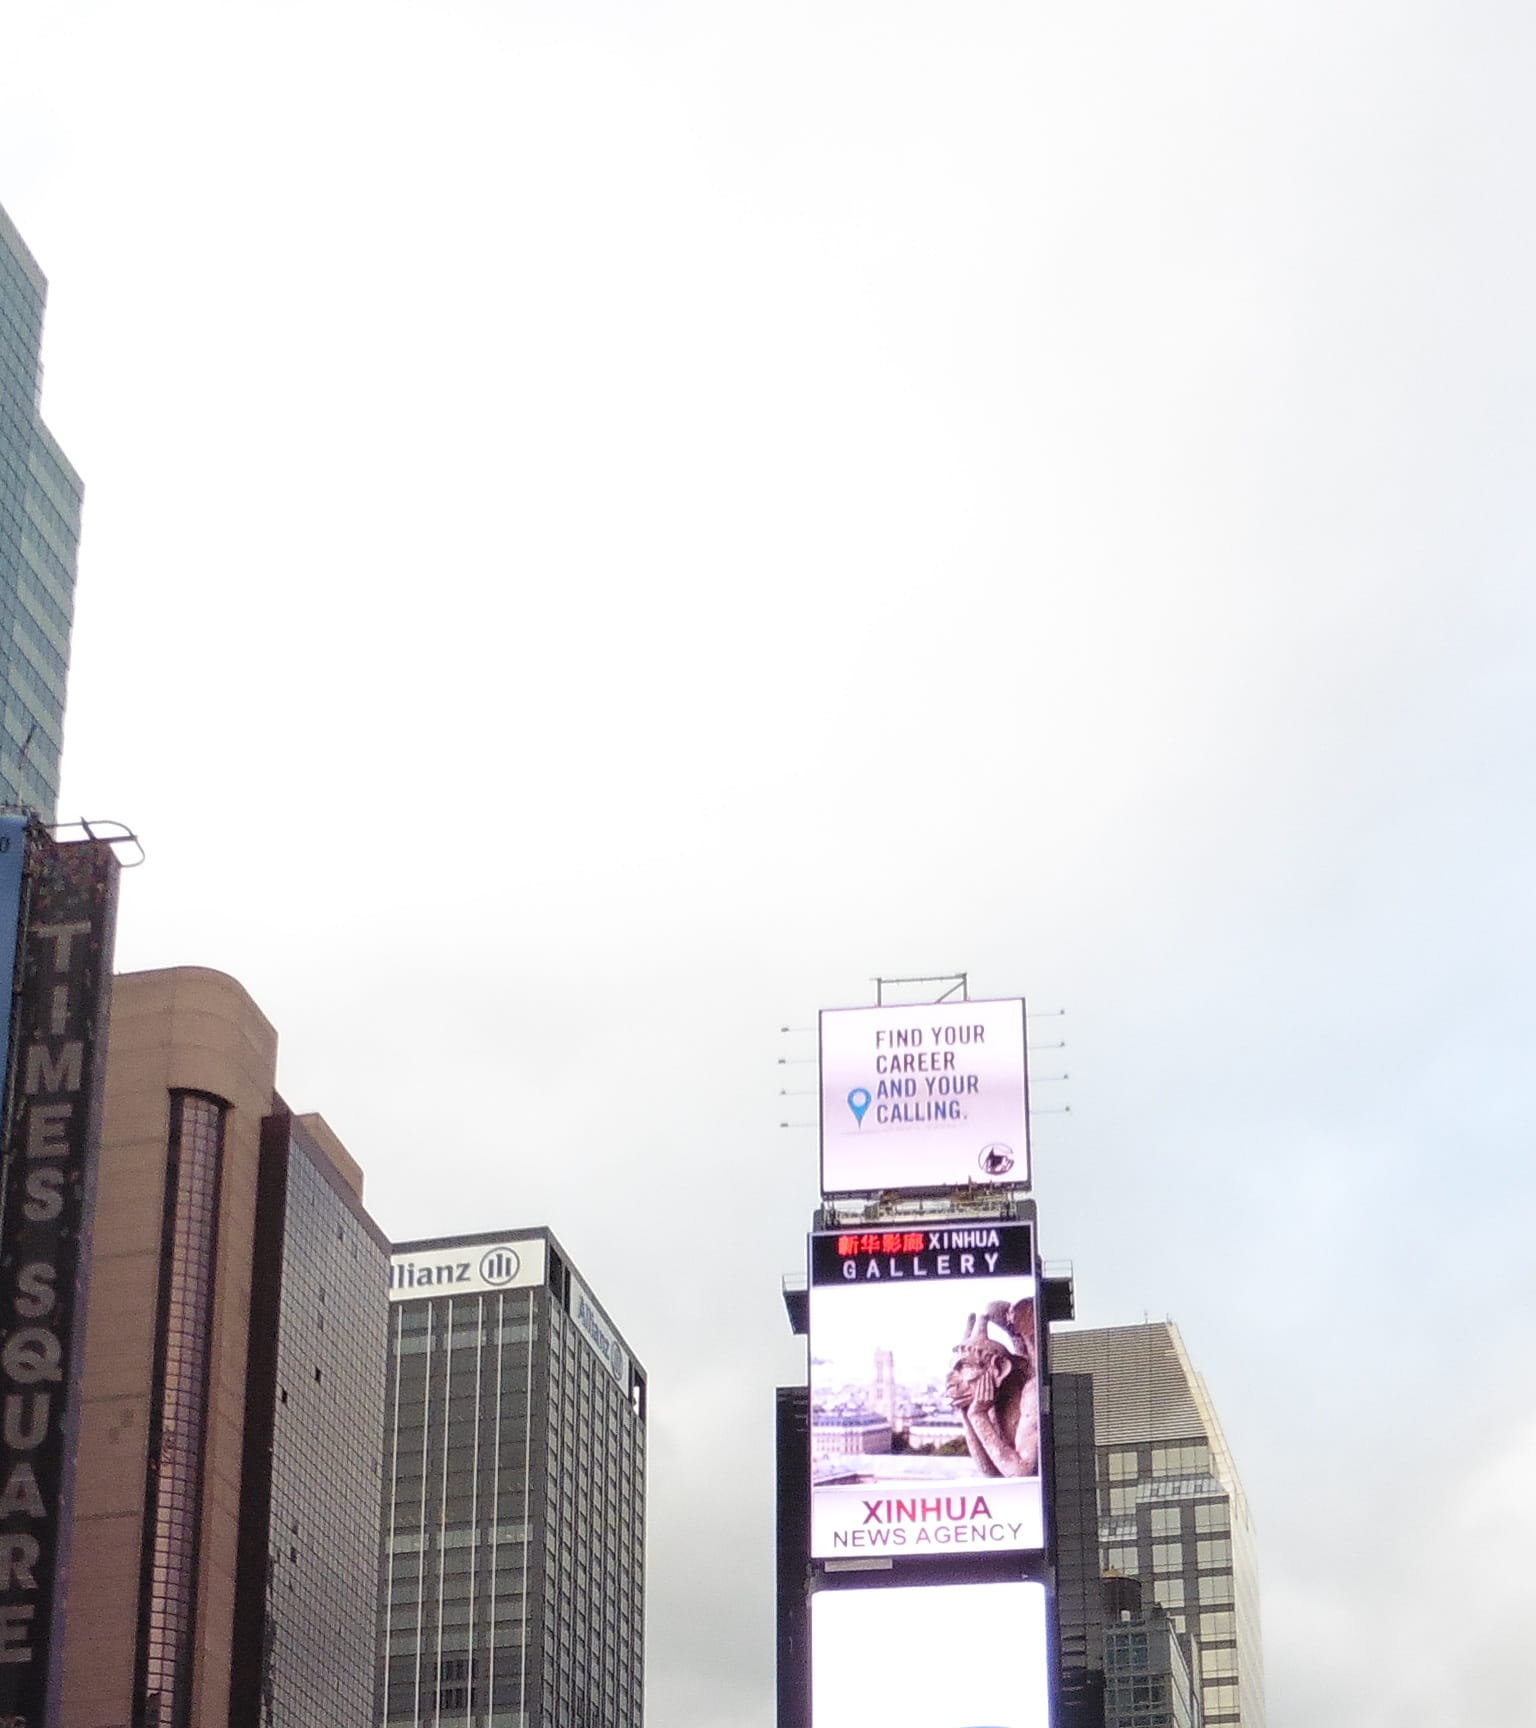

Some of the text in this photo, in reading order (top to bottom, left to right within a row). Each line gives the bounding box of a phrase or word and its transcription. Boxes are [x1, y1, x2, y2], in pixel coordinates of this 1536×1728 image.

[876, 1024, 985, 1050] FIND YOUR
[24, 920, 92, 1222] TIMES
[876, 1051, 955, 1074] CAREER
[876, 1075, 979, 1099] AND YOUR
[877, 1100, 968, 1124] CALLING.
[928, 1229, 1000, 1250] XINHUA
[843, 1253, 999, 1279] GALLERY
[862, 1495, 992, 1525] XINHUA
[833, 1523, 1024, 1549] NEWS AGENCY
